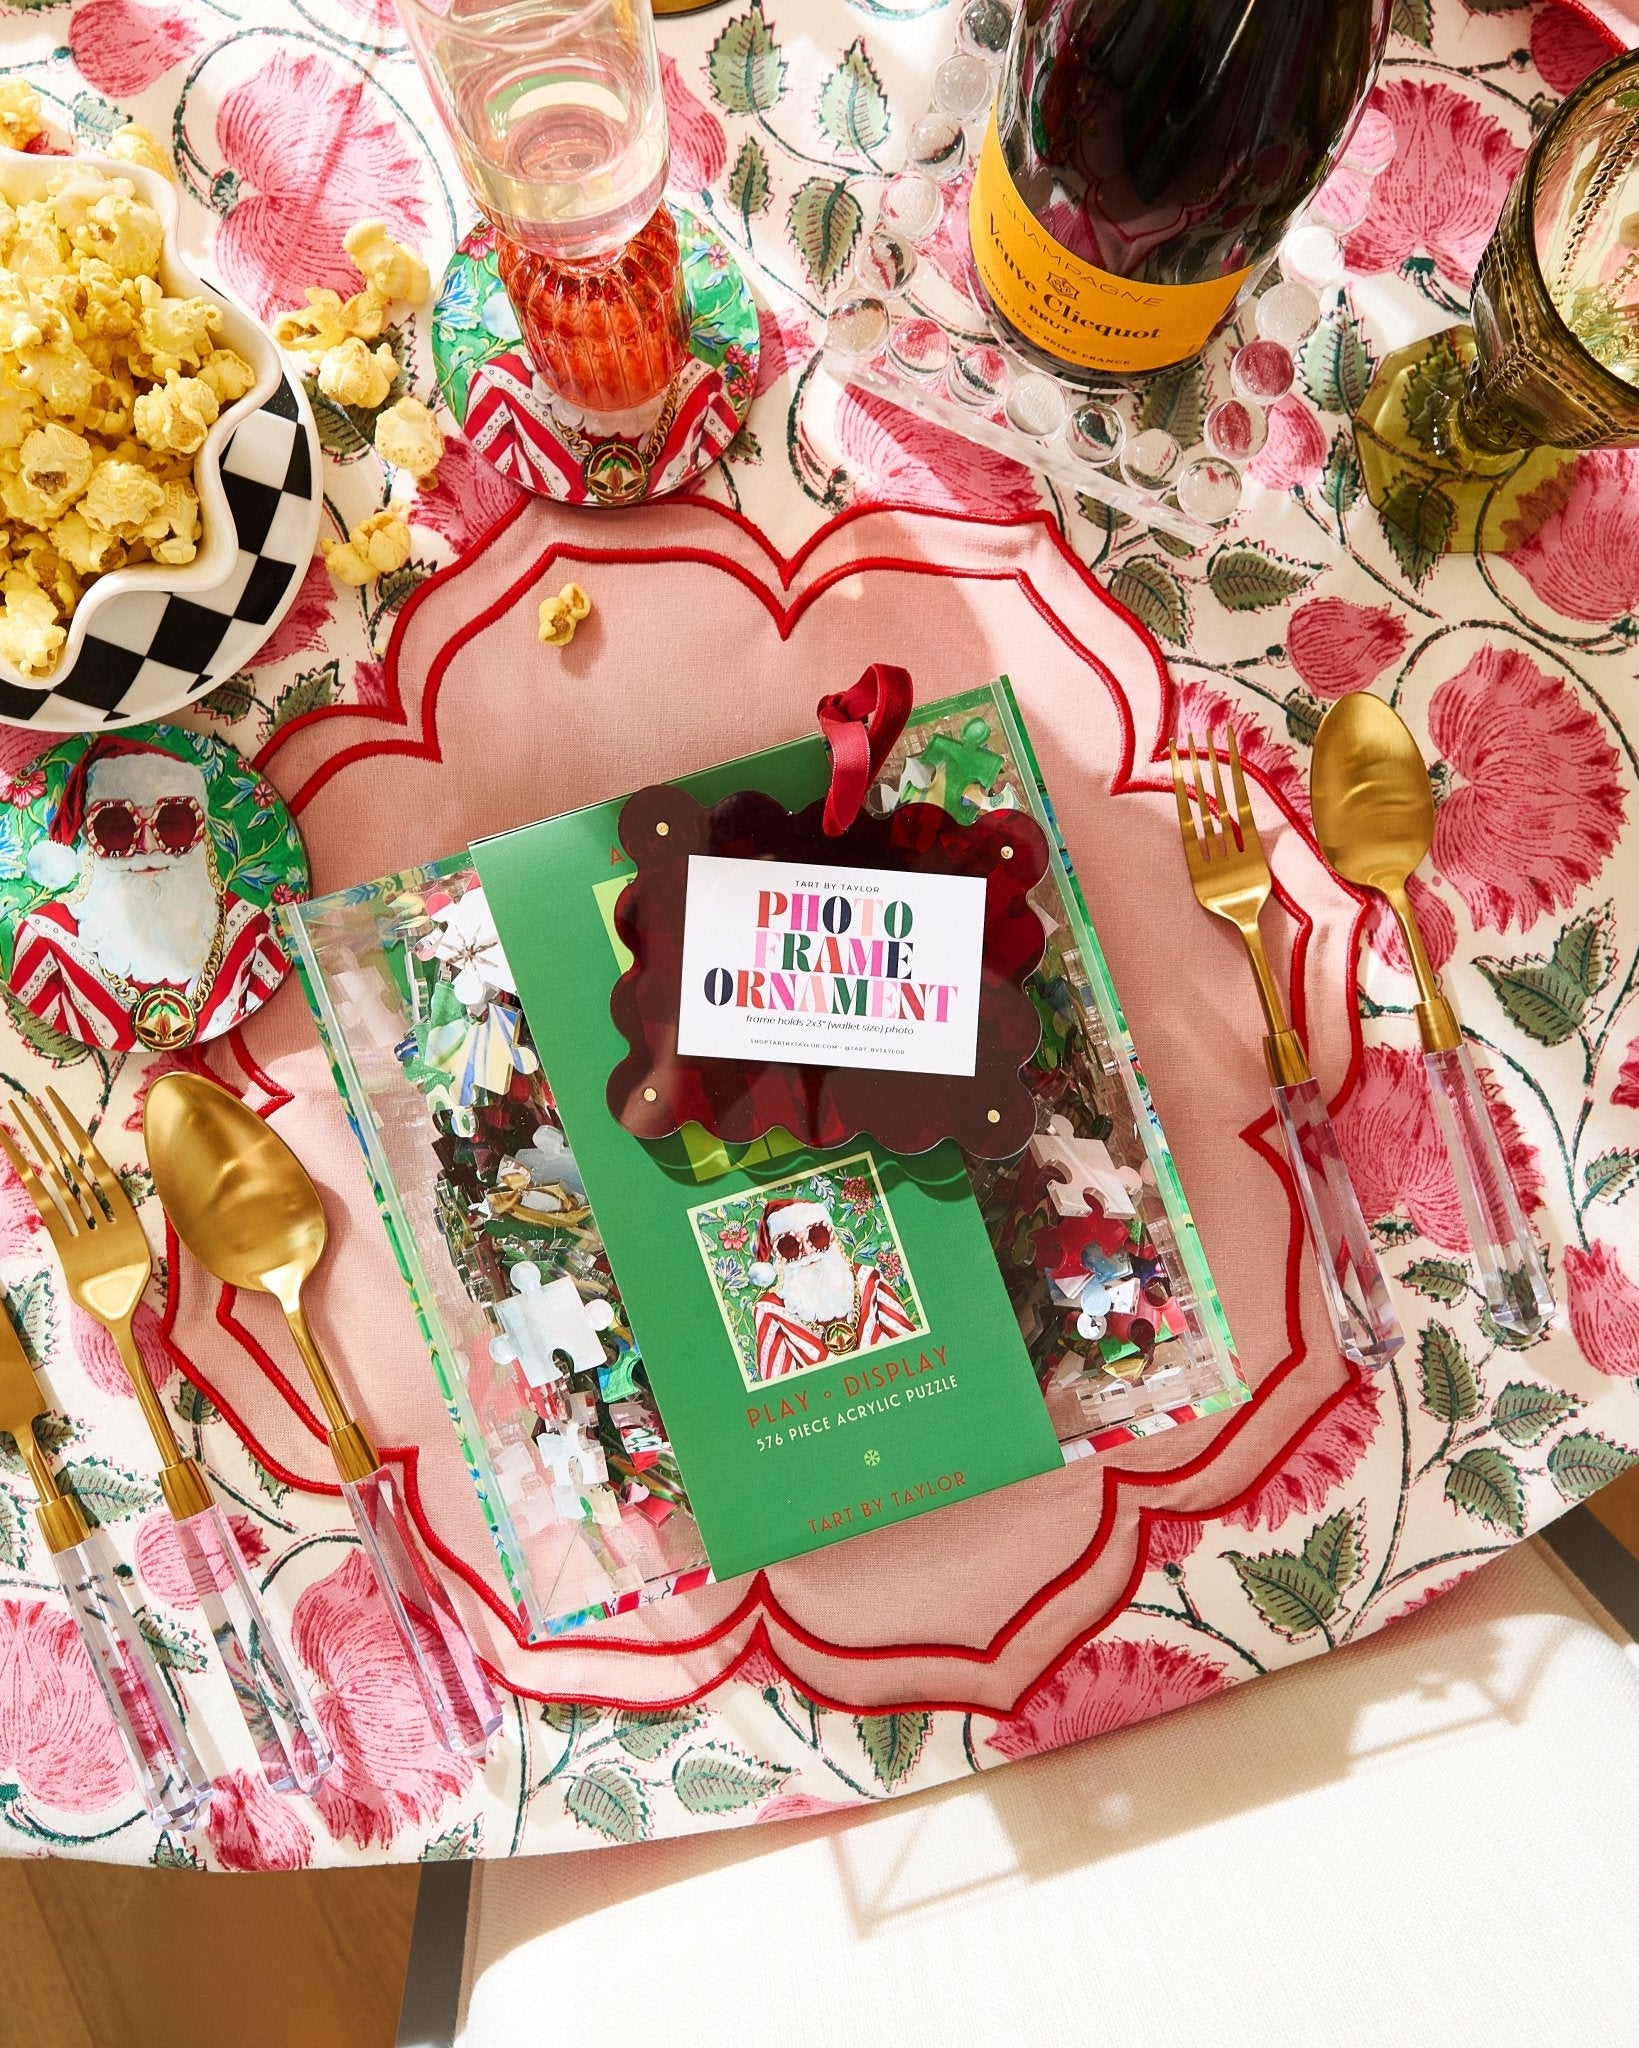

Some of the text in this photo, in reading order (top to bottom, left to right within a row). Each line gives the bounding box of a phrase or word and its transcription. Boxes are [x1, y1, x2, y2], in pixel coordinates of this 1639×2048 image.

[990, 212, 1037, 294] Veuve
[1043, 293, 1161, 339] Clicquot
[1002, 194, 1164, 307] CHAMPAGNE
[1011, 308, 1033, 329] 1772
[1029, 304, 1073, 335] BRUT
[795, 880, 880, 894] TART BY TAYLOR
[757, 890, 914, 939] PHOTO
[754, 931, 914, 980] FRAME
[703, 967, 958, 1023] ORNAMENT
[746, 1014, 776, 1025] frame
[777, 1016, 804, 1027] holds
[827, 1020, 860, 1031] (wallet
[862, 1023, 884, 1034] size)
[884, 1025, 914, 1036] photo
[746, 1346, 948, 1428] PLAY DISPLAY
[756, 1374, 959, 1453] 576 PIECE ACRYLIC PUZZLE
[808, 1471, 966, 1535] TART BY TAYLOR
